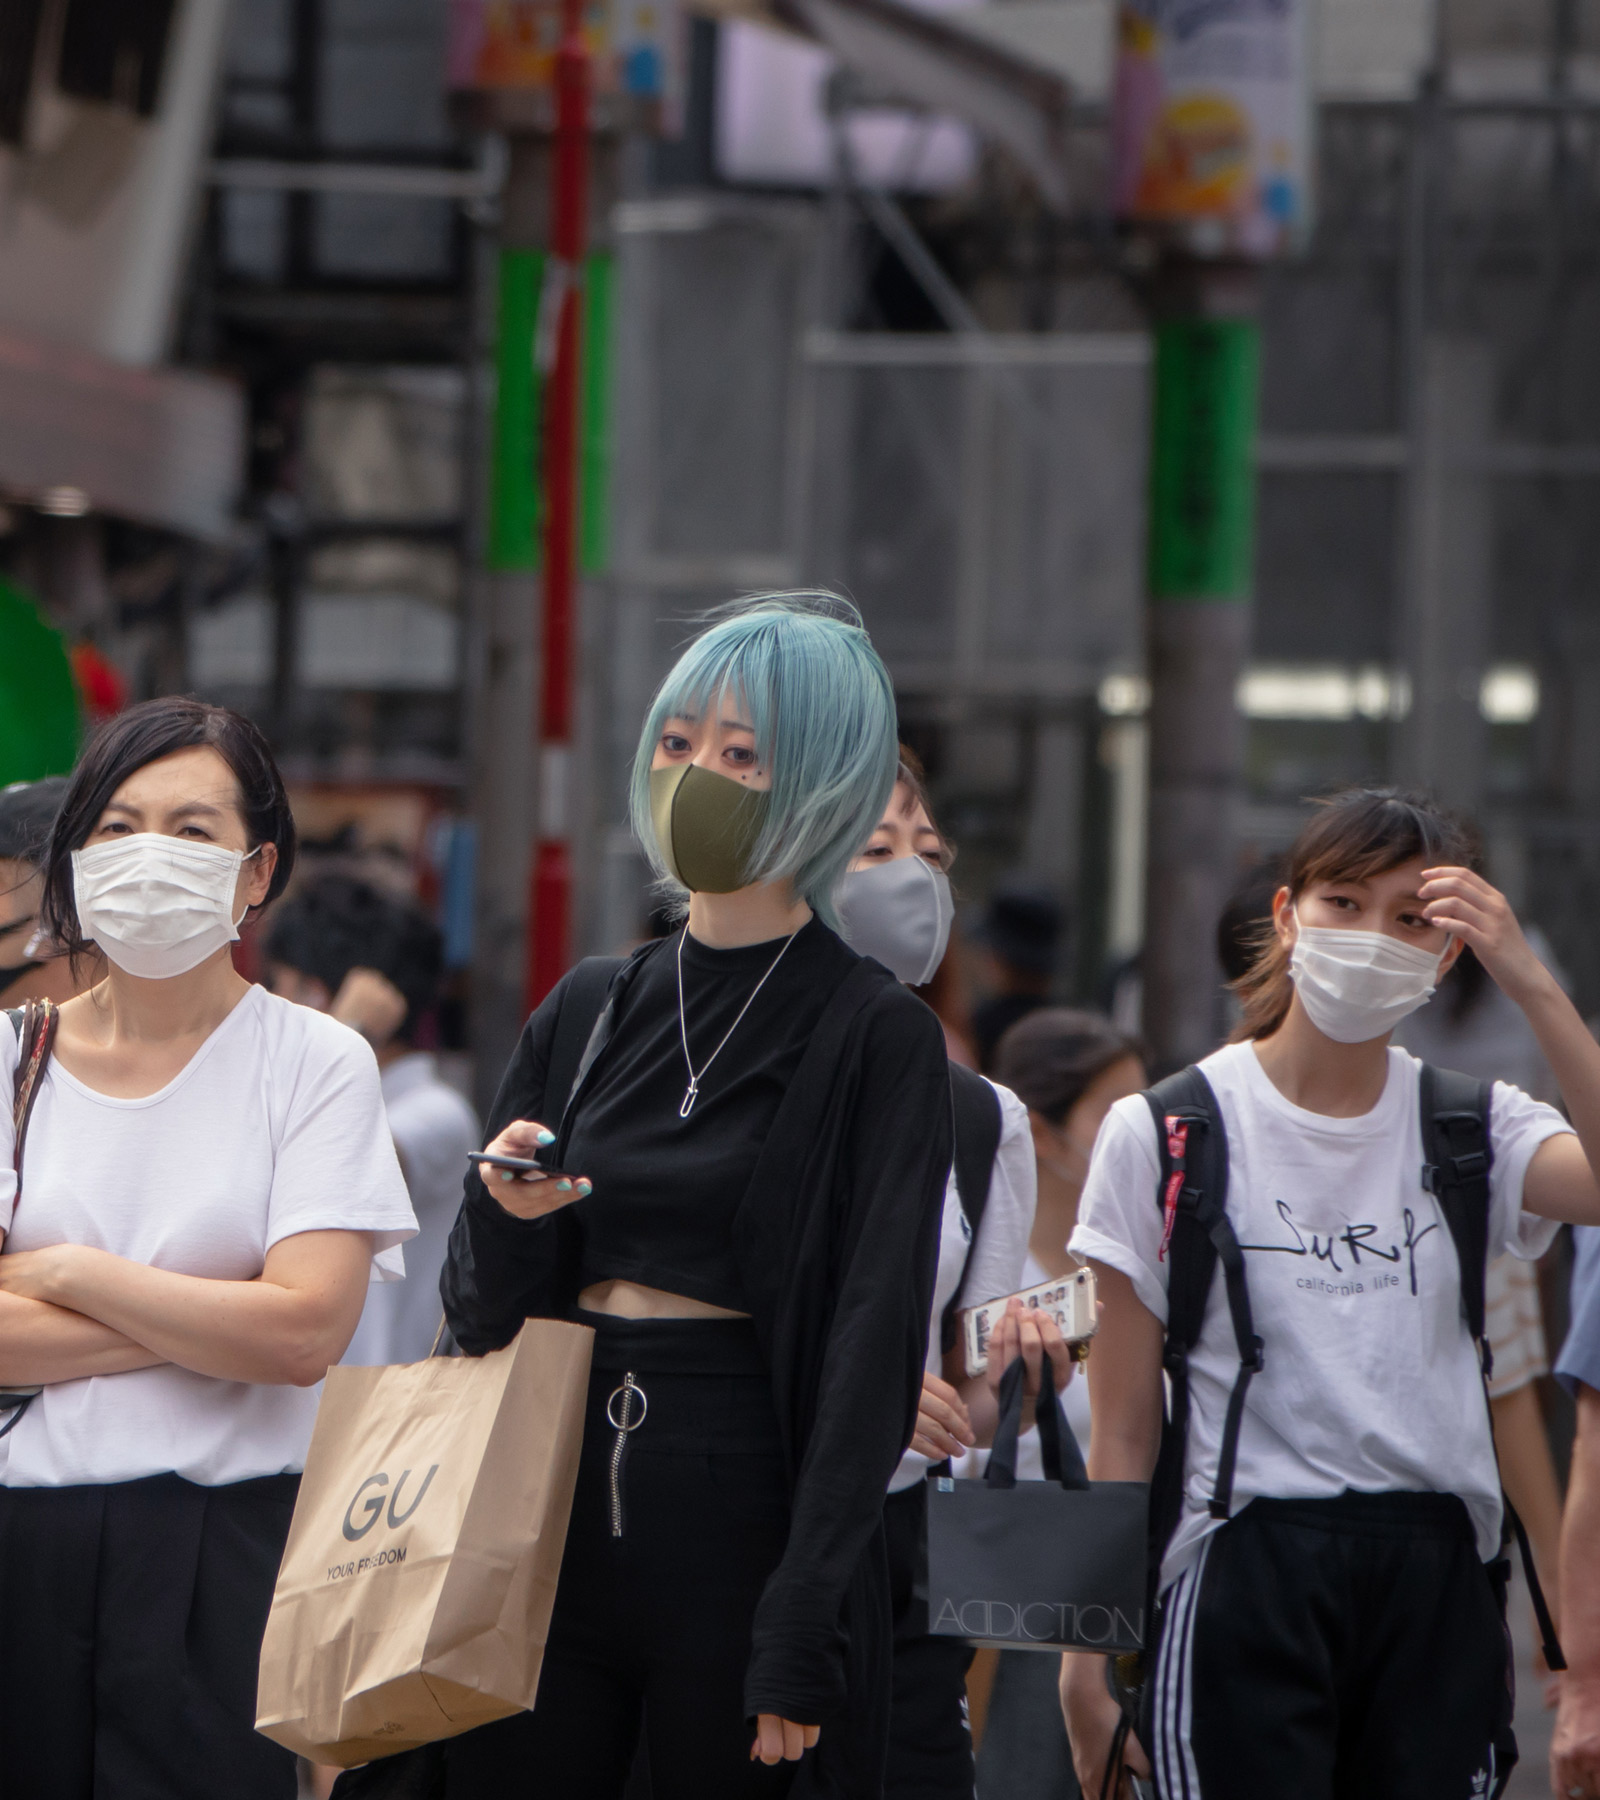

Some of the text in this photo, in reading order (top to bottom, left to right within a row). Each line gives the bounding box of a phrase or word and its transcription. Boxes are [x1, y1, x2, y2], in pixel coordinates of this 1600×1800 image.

[1296, 1273, 1400, 1296] california life
[342, 1464, 440, 1542] GU
[326, 1547, 407, 1581] YOUR FREEDOM
